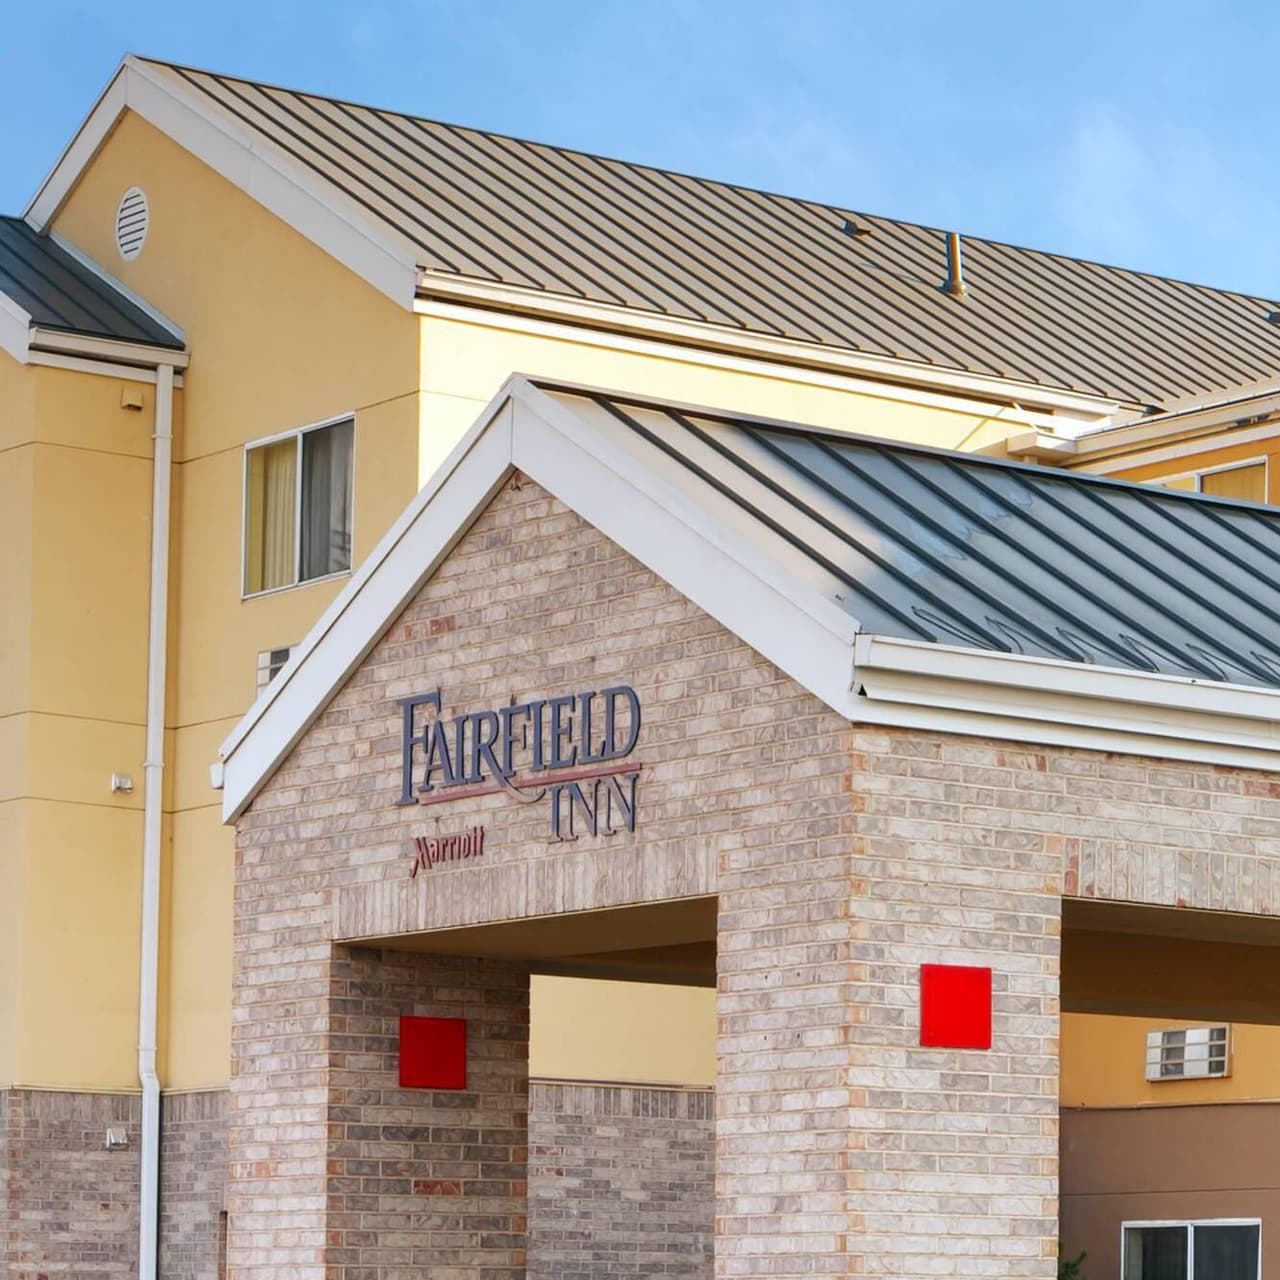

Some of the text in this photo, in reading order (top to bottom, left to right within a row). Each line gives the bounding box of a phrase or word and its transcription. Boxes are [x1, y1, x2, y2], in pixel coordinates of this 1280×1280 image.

[395, 684, 641, 806] FAIRFIELD
[548, 772, 640, 844] INN
[409, 825, 485, 879] Marriott
